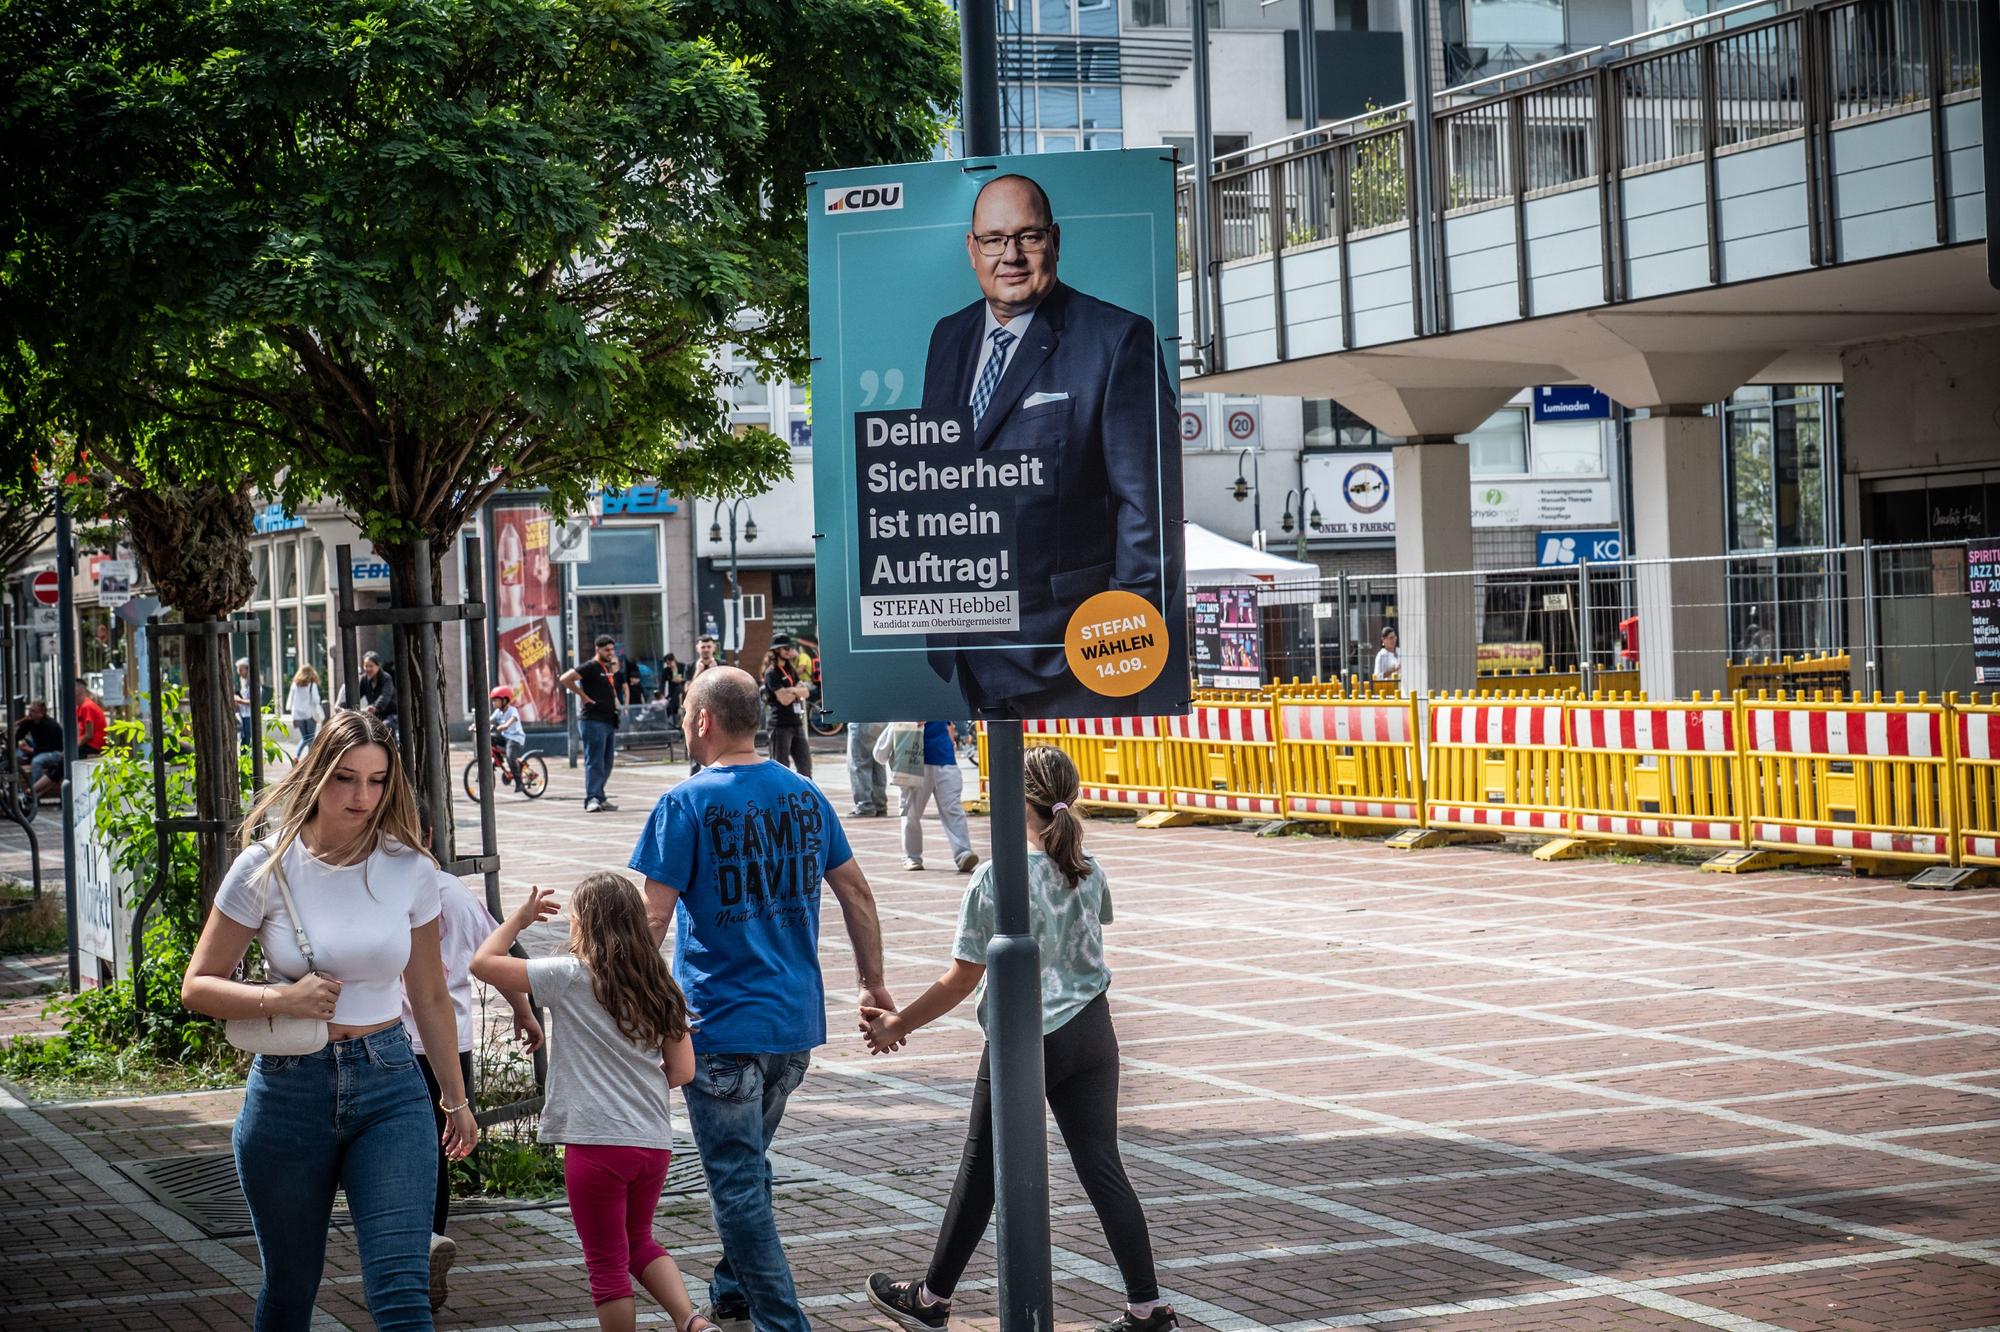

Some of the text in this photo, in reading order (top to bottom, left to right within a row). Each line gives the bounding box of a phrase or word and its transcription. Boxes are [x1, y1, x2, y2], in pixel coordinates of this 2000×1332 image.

[845, 187, 899, 209] CDU
[1543, 400, 1590, 413] Luminaden
[866, 413, 961, 447] Deine
[1234, 419, 1249, 432] 20
[868, 454, 1044, 493] Sicherheit
[869, 503, 1000, 539] ist mein
[1360, 522, 1396, 533] FAHRSC
[871, 550, 1009, 589] Auftrag!
[1970, 565, 1993, 578] JAZZ
[1970, 580, 1986, 593] LEV
[873, 595, 1012, 617] STEFAN Hebbel
[873, 619, 910, 629] Kandidat
[931, 617, 1012, 628] Oberbürgermeister
[1081, 614, 1147, 640] STEFAN
[1081, 633, 1154, 660] WÄHLEN
[1096, 657, 1147, 678] 14.09.
[711, 810, 815, 859] CAMP
[719, 855, 817, 907] DAVID
